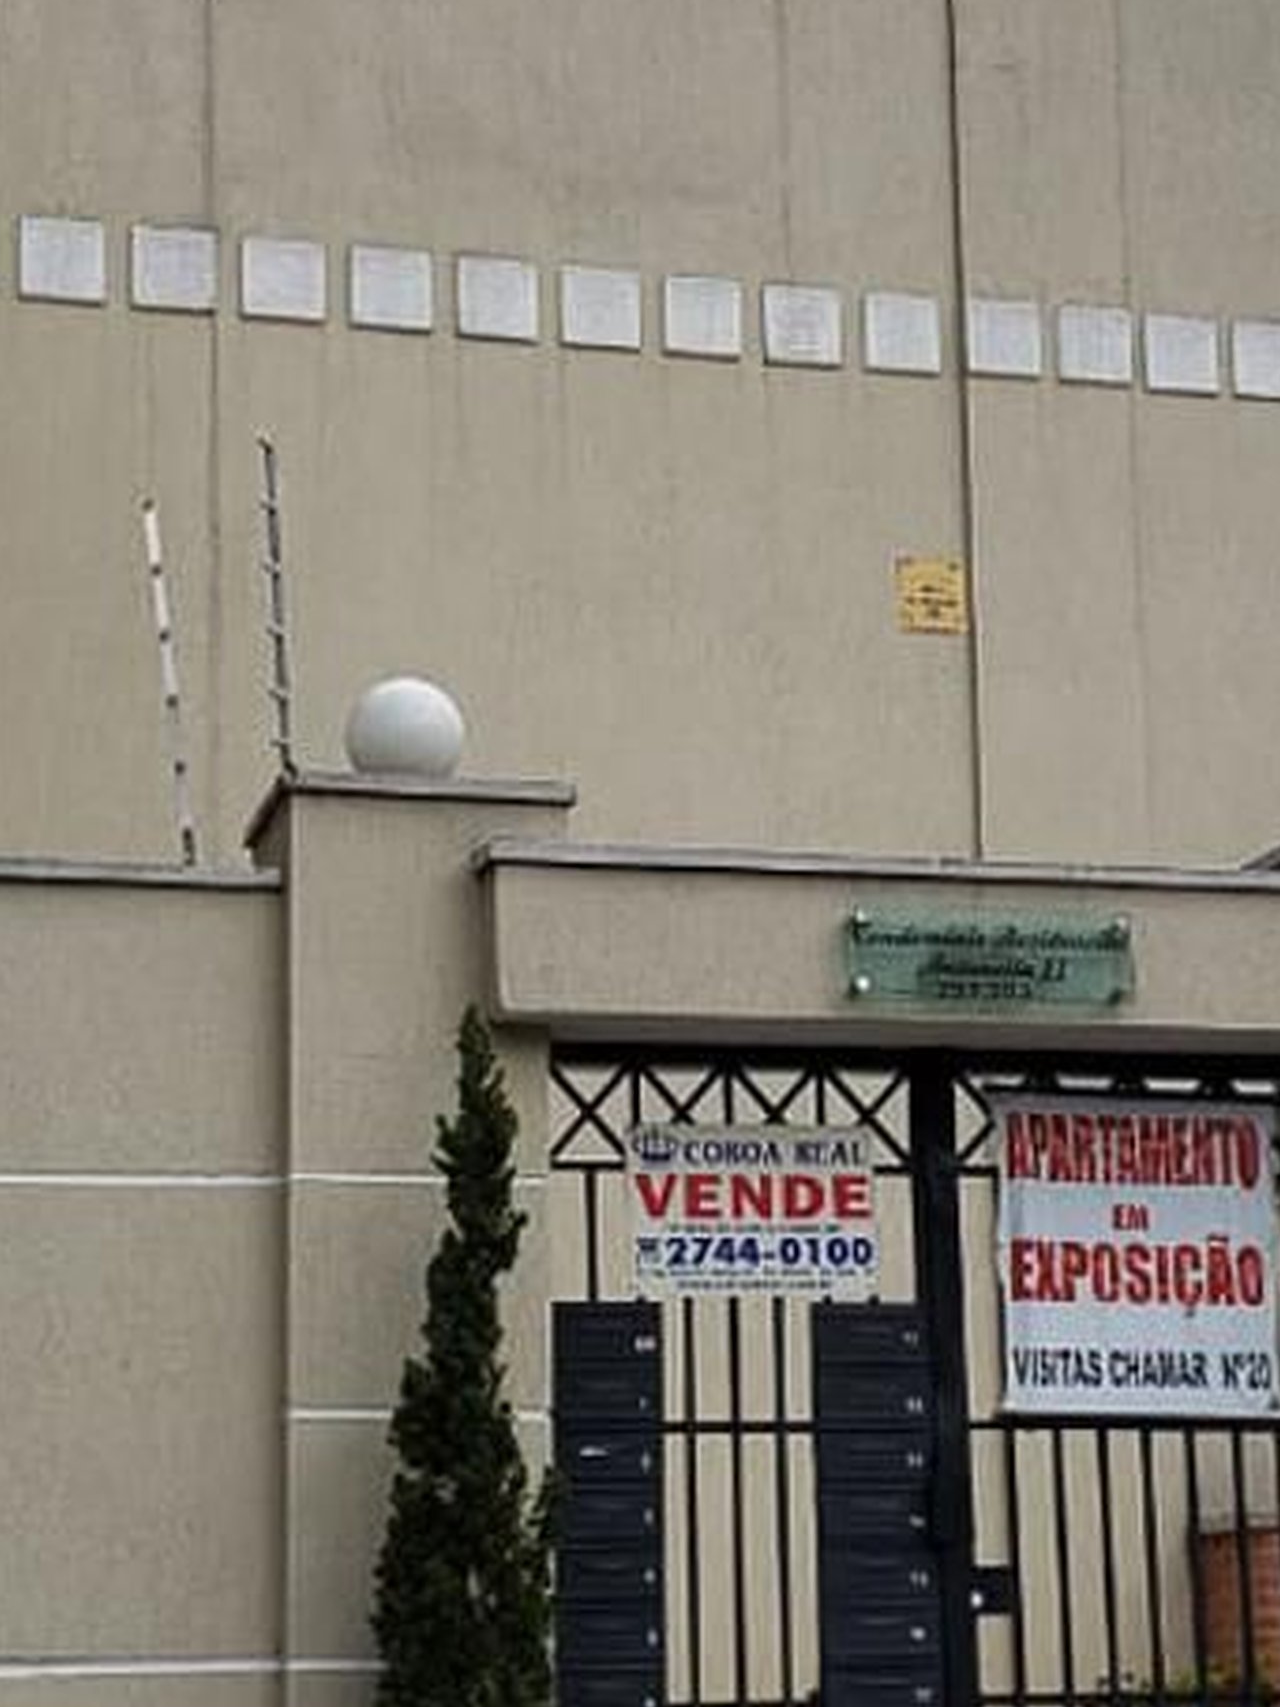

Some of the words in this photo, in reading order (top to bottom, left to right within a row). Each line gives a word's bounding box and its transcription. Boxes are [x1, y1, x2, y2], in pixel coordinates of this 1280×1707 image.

[1006, 1112, 1260, 1190] APARTAMENTO
[636, 1174, 872, 1219] VENDE
[1112, 1203, 1149, 1231] EM
[666, 1237, 872, 1266] 2744-0100
[1010, 1232, 1265, 1317] EXPOSIÇÃO
[1013, 1346, 1102, 1387] VISITAS
[1109, 1350, 1208, 1388] CHAMAR
